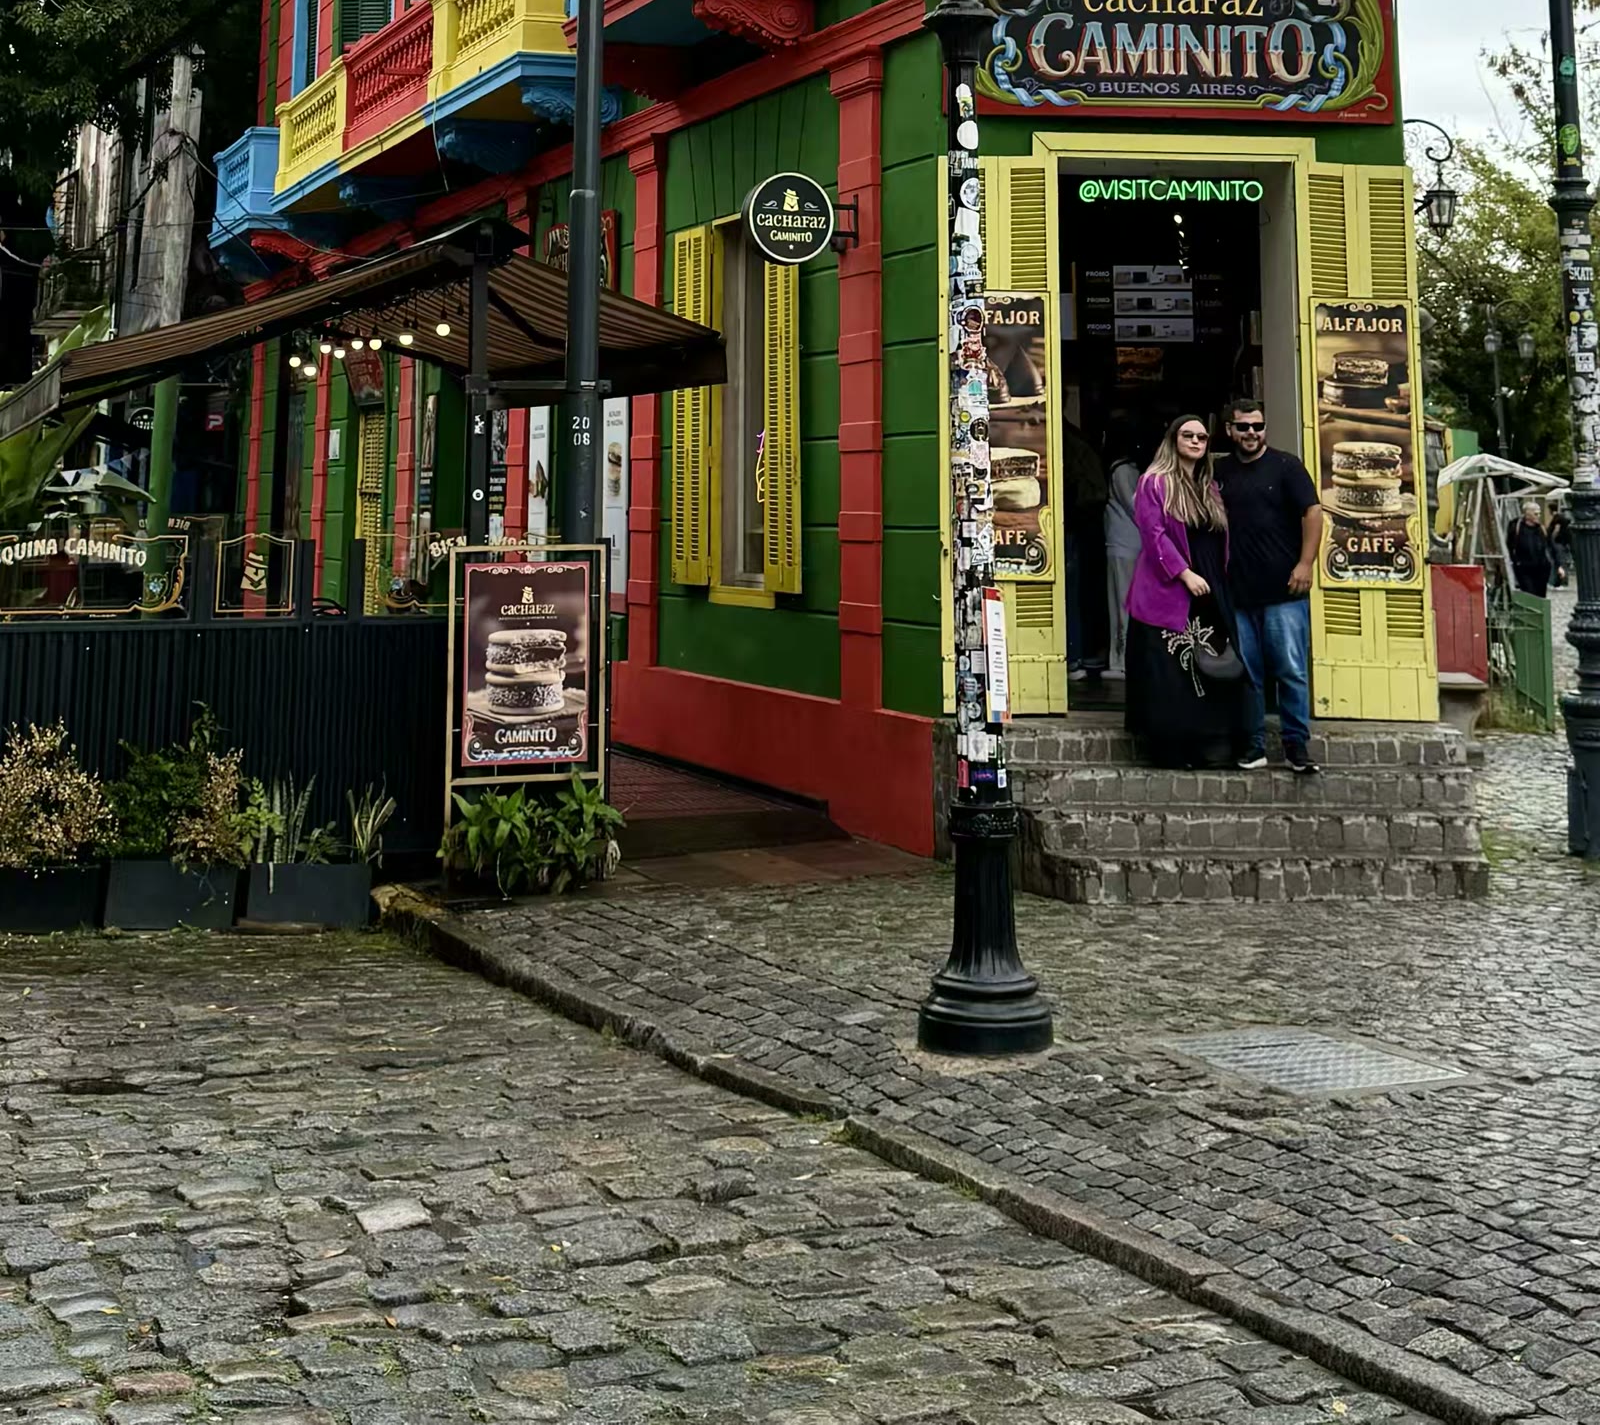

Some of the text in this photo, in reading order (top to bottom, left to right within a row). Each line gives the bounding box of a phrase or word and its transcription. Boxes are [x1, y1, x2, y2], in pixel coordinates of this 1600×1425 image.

[1027, 12, 1317, 83] CAMINITO
[1100, 82, 1247, 96] BUENOS AIRES
[1079, 179, 1263, 202] @VISITCAMINITO
[770, 230, 813, 242] CAMINITO
[985, 309, 1040, 324] FAJOR
[1322, 317, 1403, 333] ALFAJOR
[572, 416, 590, 429] 20
[573, 432, 590, 446] 08
[993, 529, 1027, 545] AFE
[0, 538, 147, 567] QUINA CAMINITO
[1347, 537, 1396, 554] CAFE
[495, 727, 557, 744] CAMINITO
